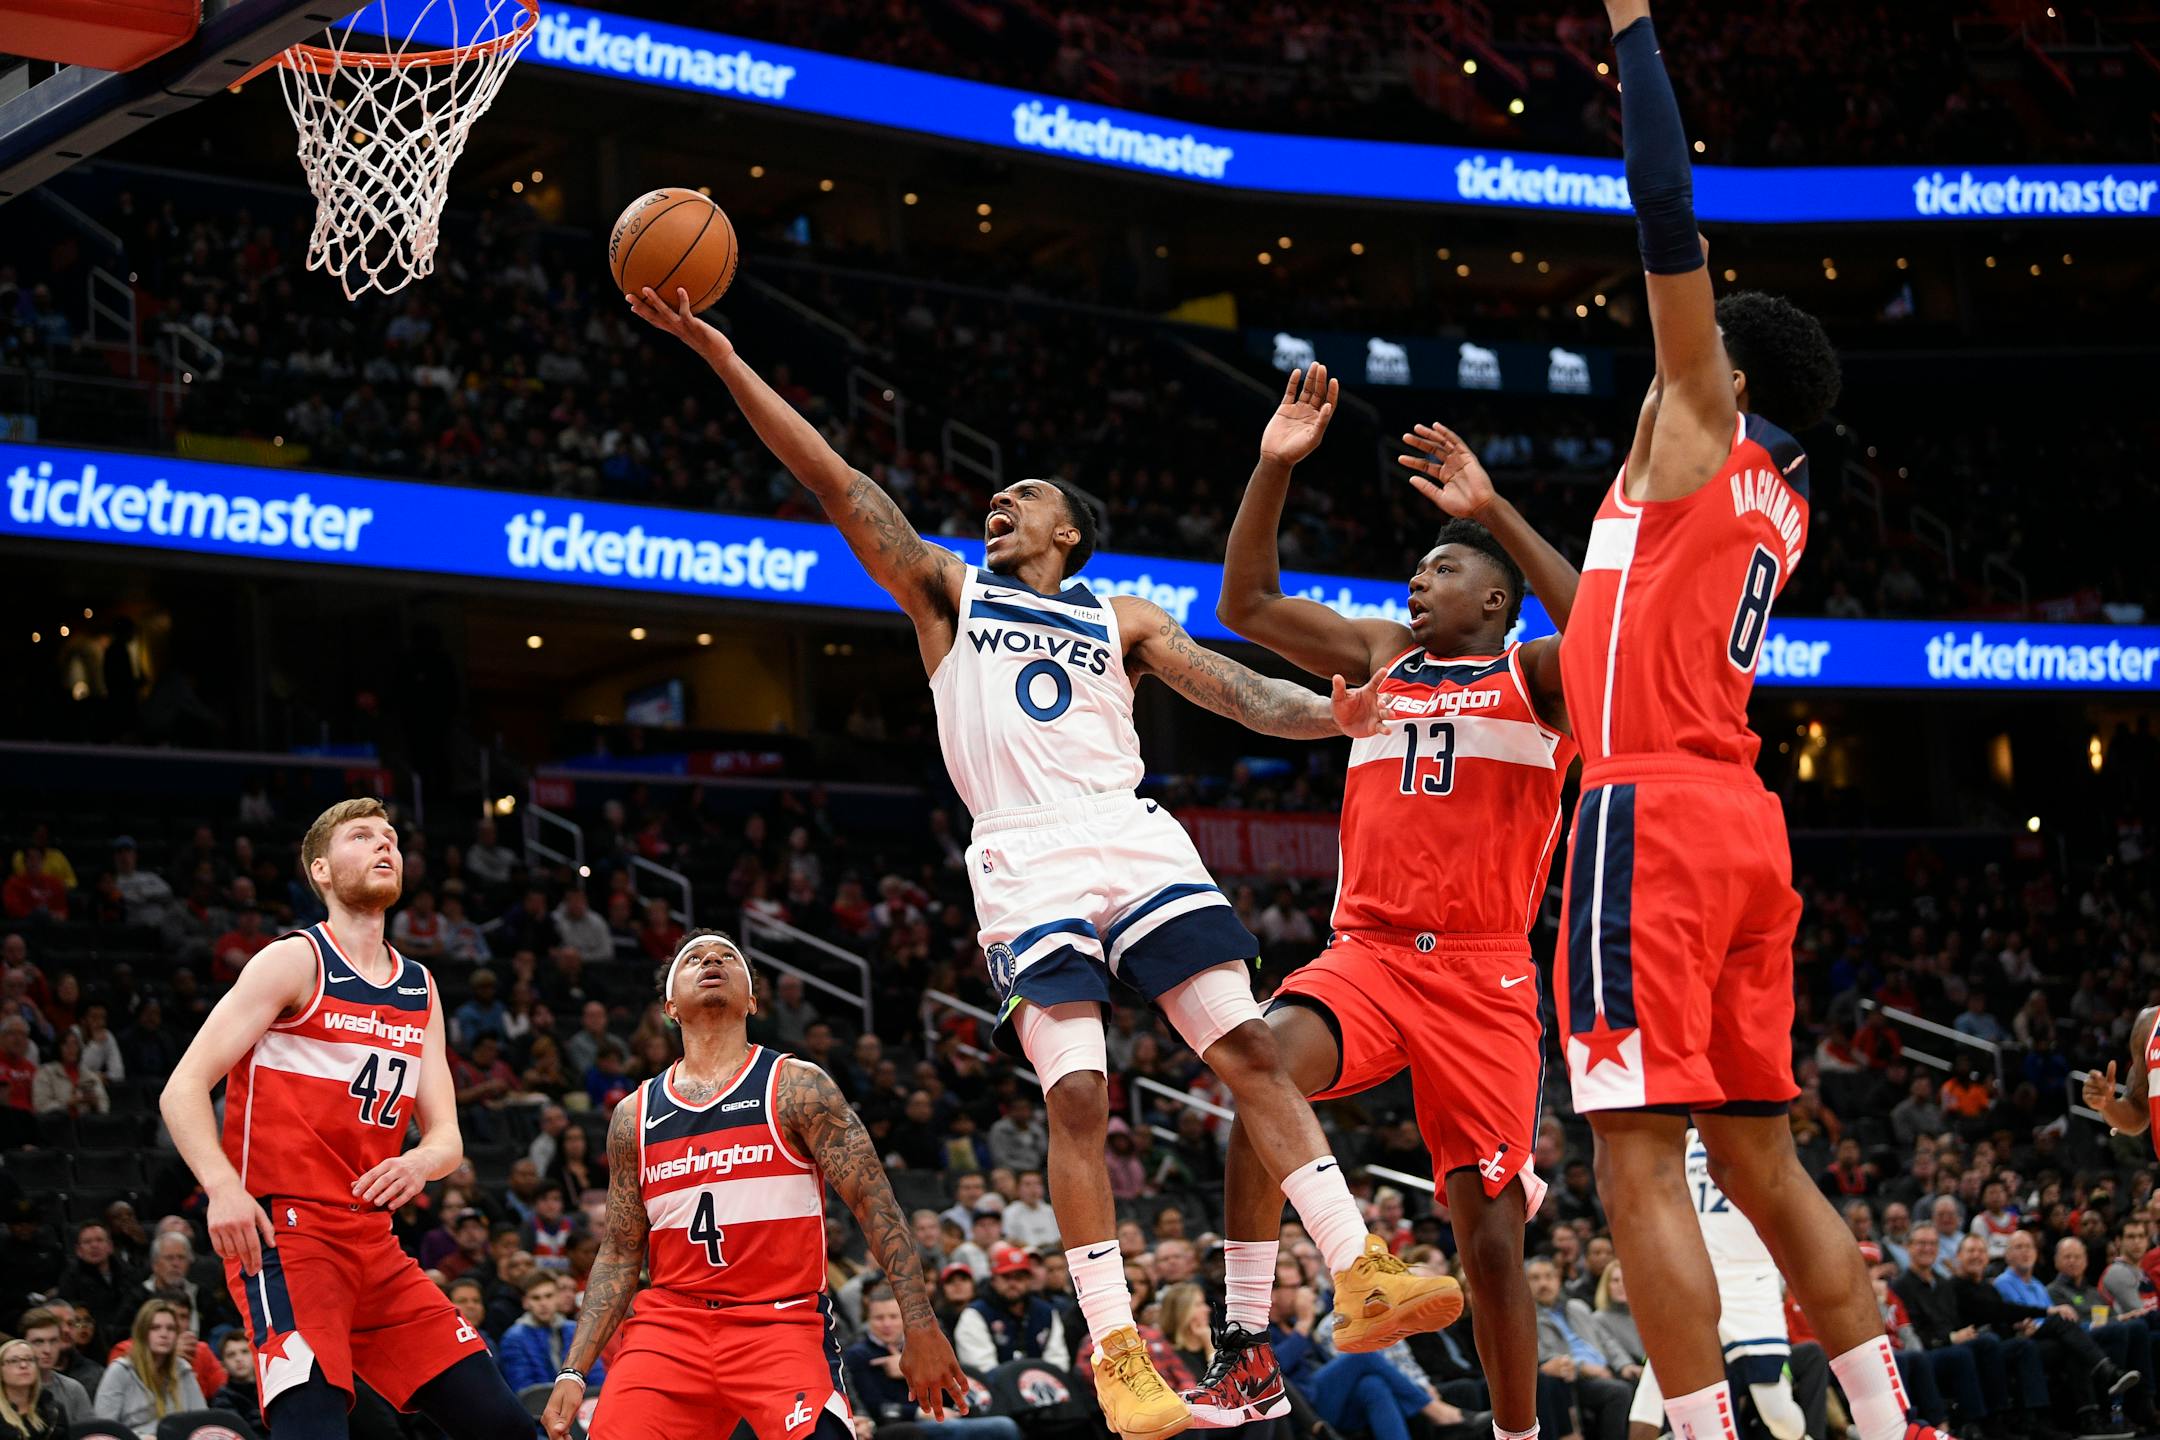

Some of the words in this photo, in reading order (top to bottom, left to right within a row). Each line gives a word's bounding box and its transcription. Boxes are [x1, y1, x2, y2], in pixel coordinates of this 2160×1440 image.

[536, 12, 796, 100] ticketmaster
[1012, 100, 1234, 179] ticketmaster
[1455, 155, 1632, 210] ticketmas
[1913, 171, 2158, 215] ticketmaster
[7, 461, 374, 551] ticketmaster
[1730, 469, 1801, 575] HACHIMURA
[505, 510, 818, 592] ticketmaster
[1073, 608, 1100, 621] fitbit
[1727, 542, 1780, 674] 8
[967, 628, 1111, 676] WOLVES
[1925, 632, 2159, 682] ticketmaster
[1015, 658, 1072, 723] 0
[1386, 688, 1500, 717] ashington
[1399, 722, 1456, 796] 13
[323, 1010, 425, 1048] washingto
[348, 1052, 408, 1129] 42
[721, 1099, 760, 1112] GEICO
[646, 1143, 774, 1184] washington
[687, 1190, 728, 1267] 4
